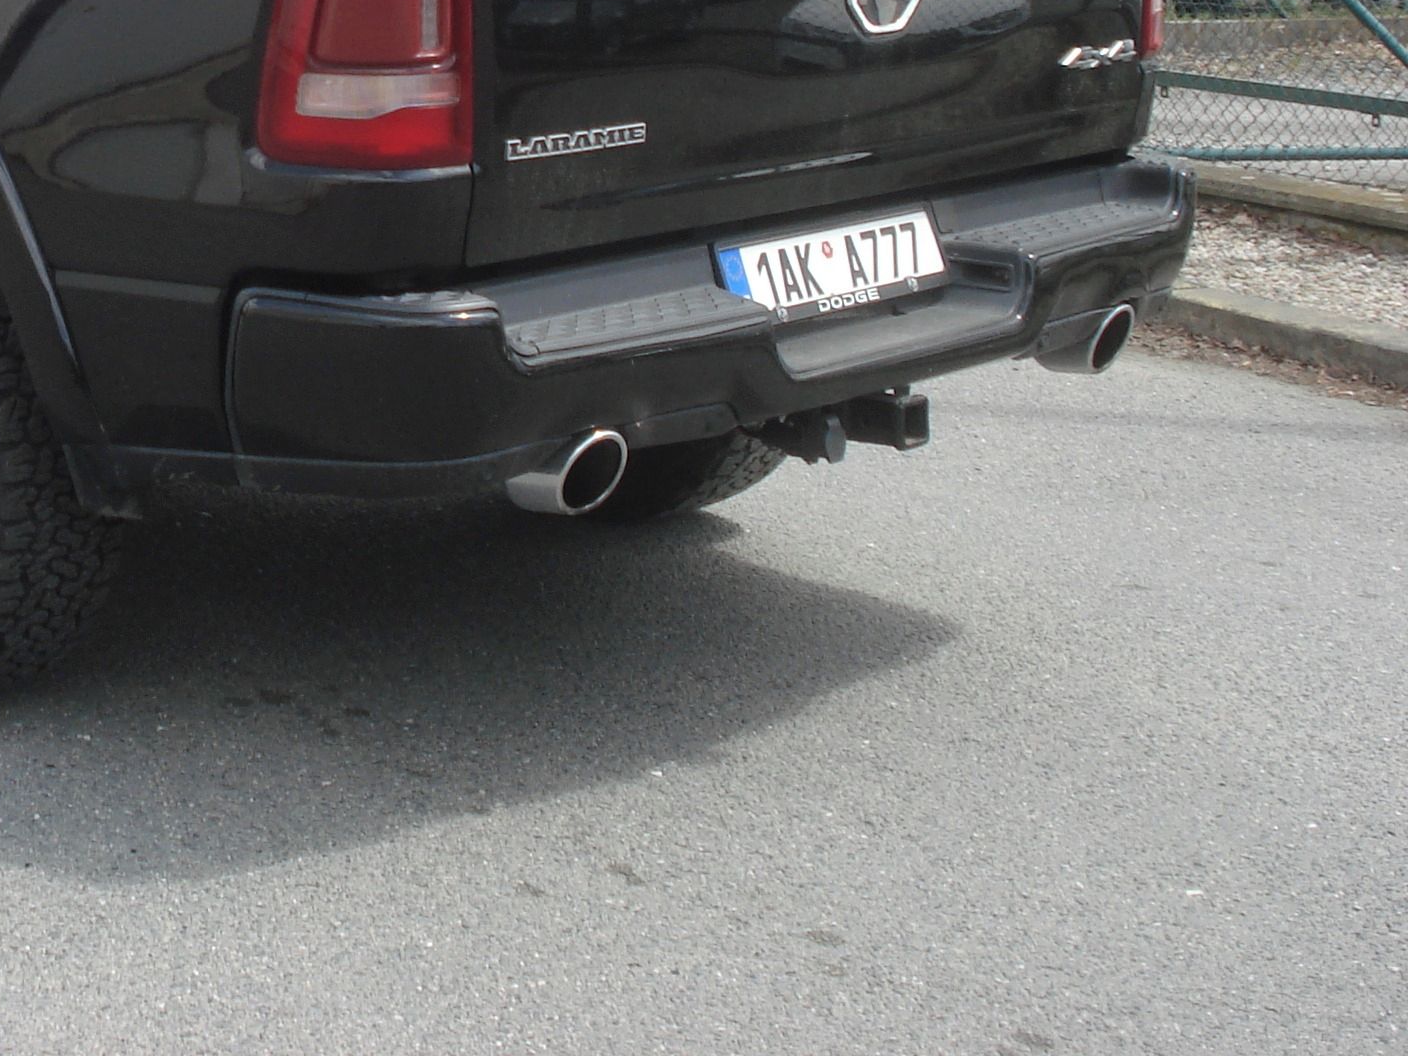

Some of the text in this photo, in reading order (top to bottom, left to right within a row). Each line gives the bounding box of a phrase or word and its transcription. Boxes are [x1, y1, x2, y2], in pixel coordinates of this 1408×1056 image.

[505, 122, 647, 161] LARAMIE
[756, 221, 919, 306] 1AK A777
[817, 287, 880, 313] DODGE
